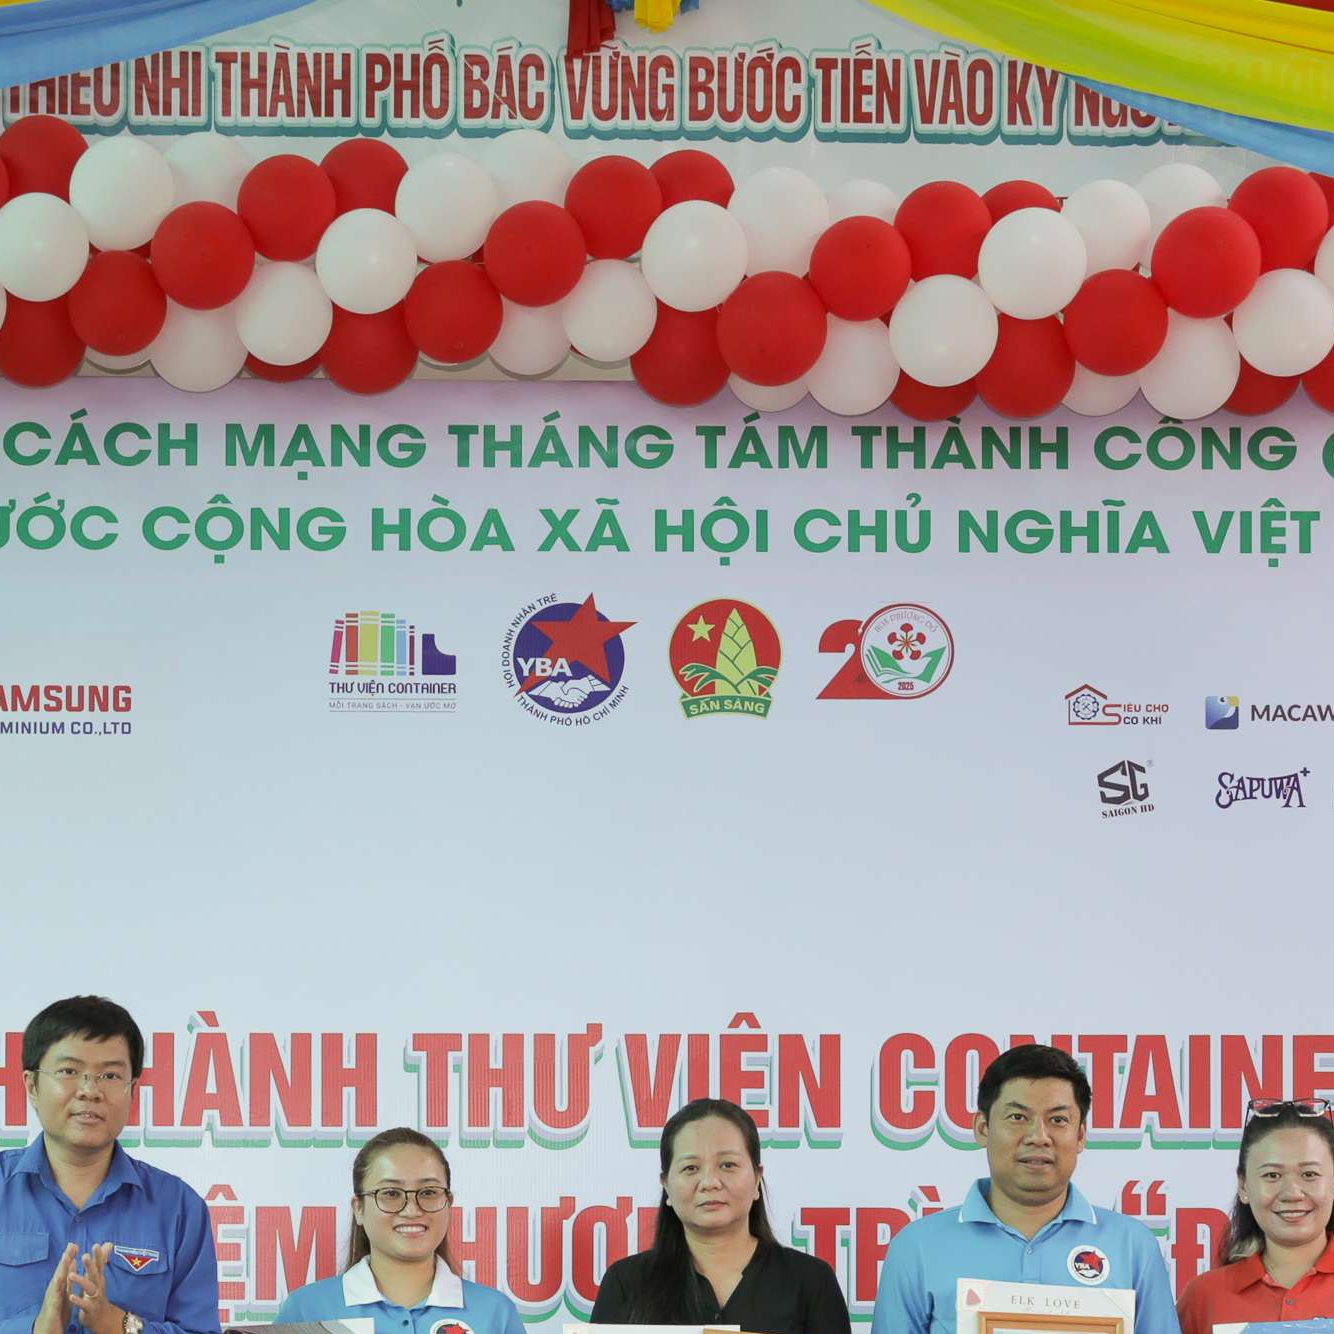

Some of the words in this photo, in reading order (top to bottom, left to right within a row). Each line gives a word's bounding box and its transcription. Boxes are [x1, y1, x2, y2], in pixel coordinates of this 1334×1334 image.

[134, 50, 202, 118] NHI
[215, 43, 351, 119] THÀNH
[367, 37, 450, 120] PHỐ
[465, 44, 545, 121] BÁC
[683, 46, 804, 124] BƯỚC
[816, 42, 908, 125] TIẾN
[916, 50, 1000, 126] VÀO
[2, 409, 198, 466] CÁCH
[225, 423, 426, 480] MẠNG
[448, 411, 674, 469] THÁNG
[696, 412, 828, 469] TÁM
[851, 416, 1069, 470] THÀNH
[1094, 416, 1297, 471] CÔNG
[142, 494, 346, 564] CỘNG
[372, 494, 515, 552] HÒA
[537, 497, 637, 553] XÃ
[655, 496, 768, 566] HỘI
[794, 492, 931, 553] CHỦ
[959, 499, 1170, 554] NGHĨA
[1191, 498, 1320, 567] VIỆT
[388, 682, 457, 694] CONTAINER
[516, 657, 573, 677] YBA
[1101, 806, 1138, 819] SAIGON
[1140, 804, 1155, 814] HD
[125, 1010, 376, 1126] HÀNH
[414, 1023, 601, 1127] THƯ
[1011, 1295, 1035, 1305] ELK
[1045, 1295, 1081, 1309] LOVE
